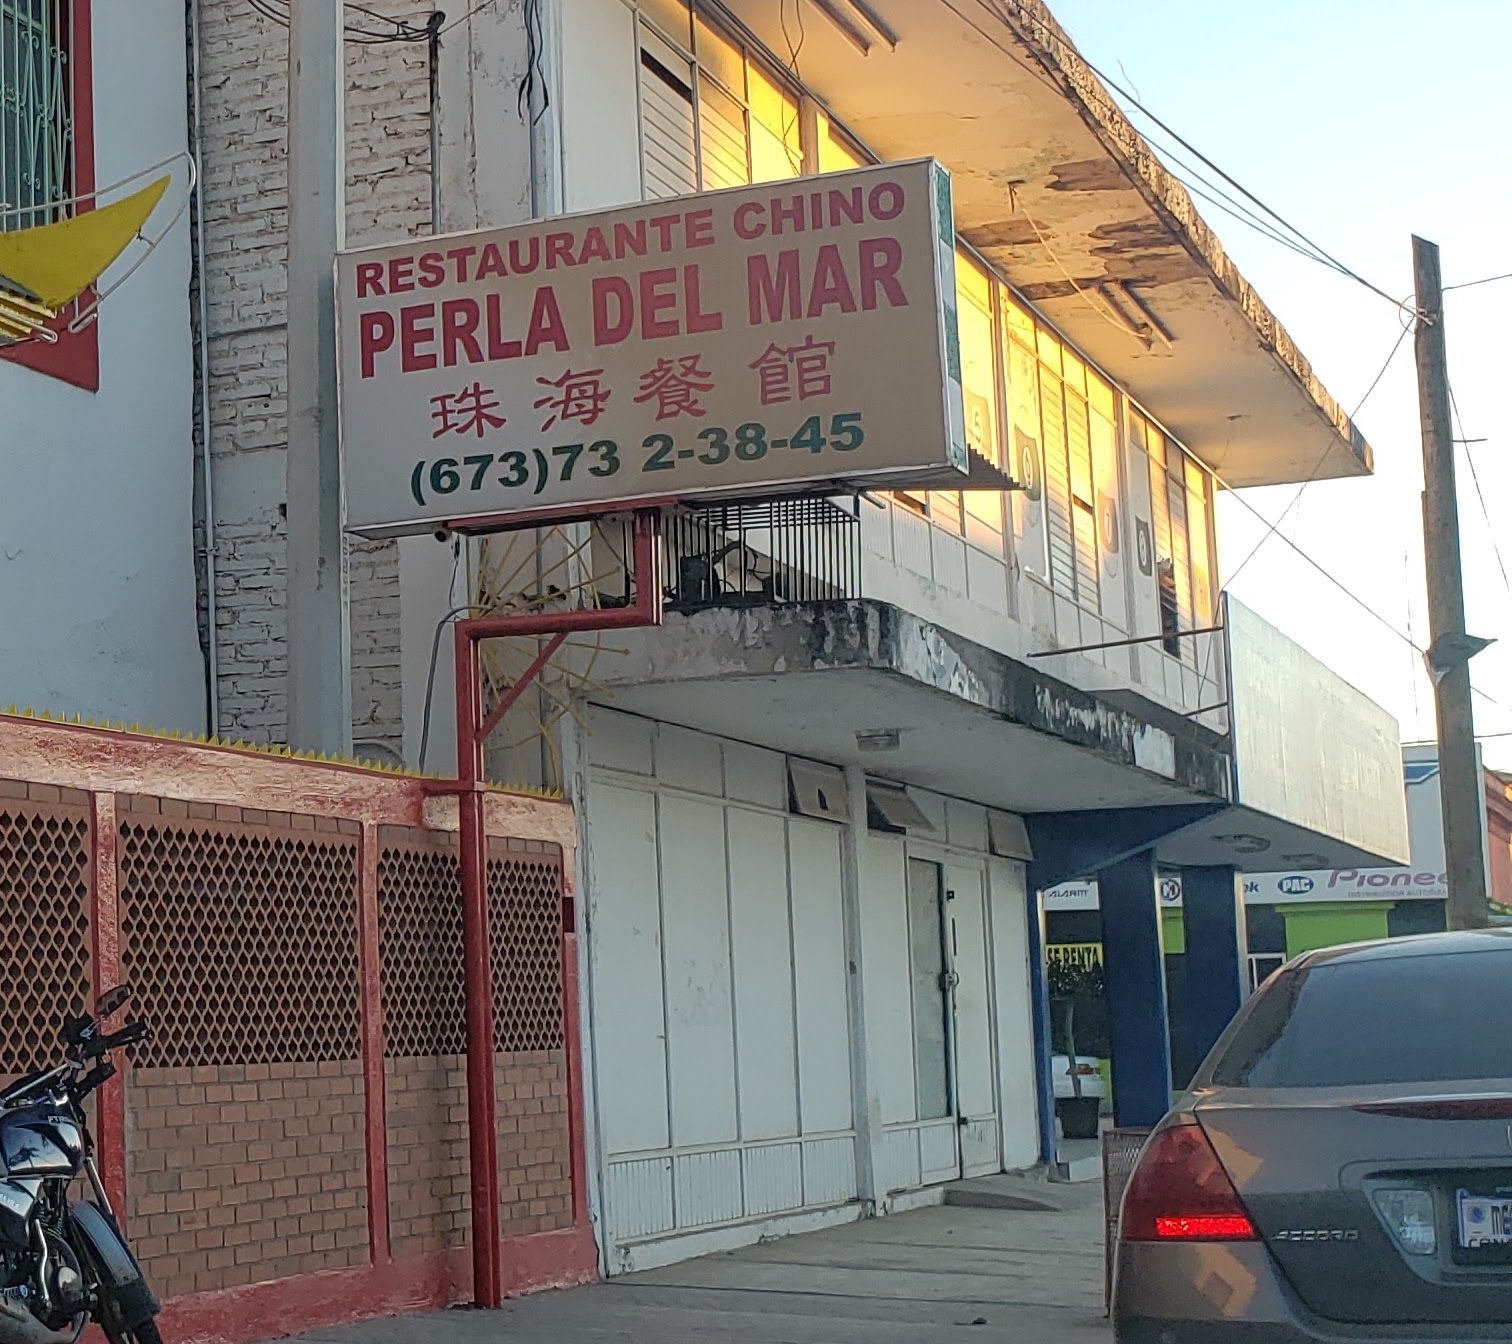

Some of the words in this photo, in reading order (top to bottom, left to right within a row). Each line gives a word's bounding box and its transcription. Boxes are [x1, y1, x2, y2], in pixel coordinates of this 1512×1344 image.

[355, 207, 715, 299] RESTAURANTE
[732, 181, 906, 240] CHINO
[360, 285, 570, 379] PERLA
[592, 264, 723, 347] DEL
[747, 236, 909, 326] MAR
[430, 334, 835, 439] 珠海餐館
[410, 439, 621, 506] (673)73
[641, 411, 866, 473] 2-38-45
[1281, 878, 1311, 892] PAC
[1271, 1229, 1359, 1242] ACCORD
